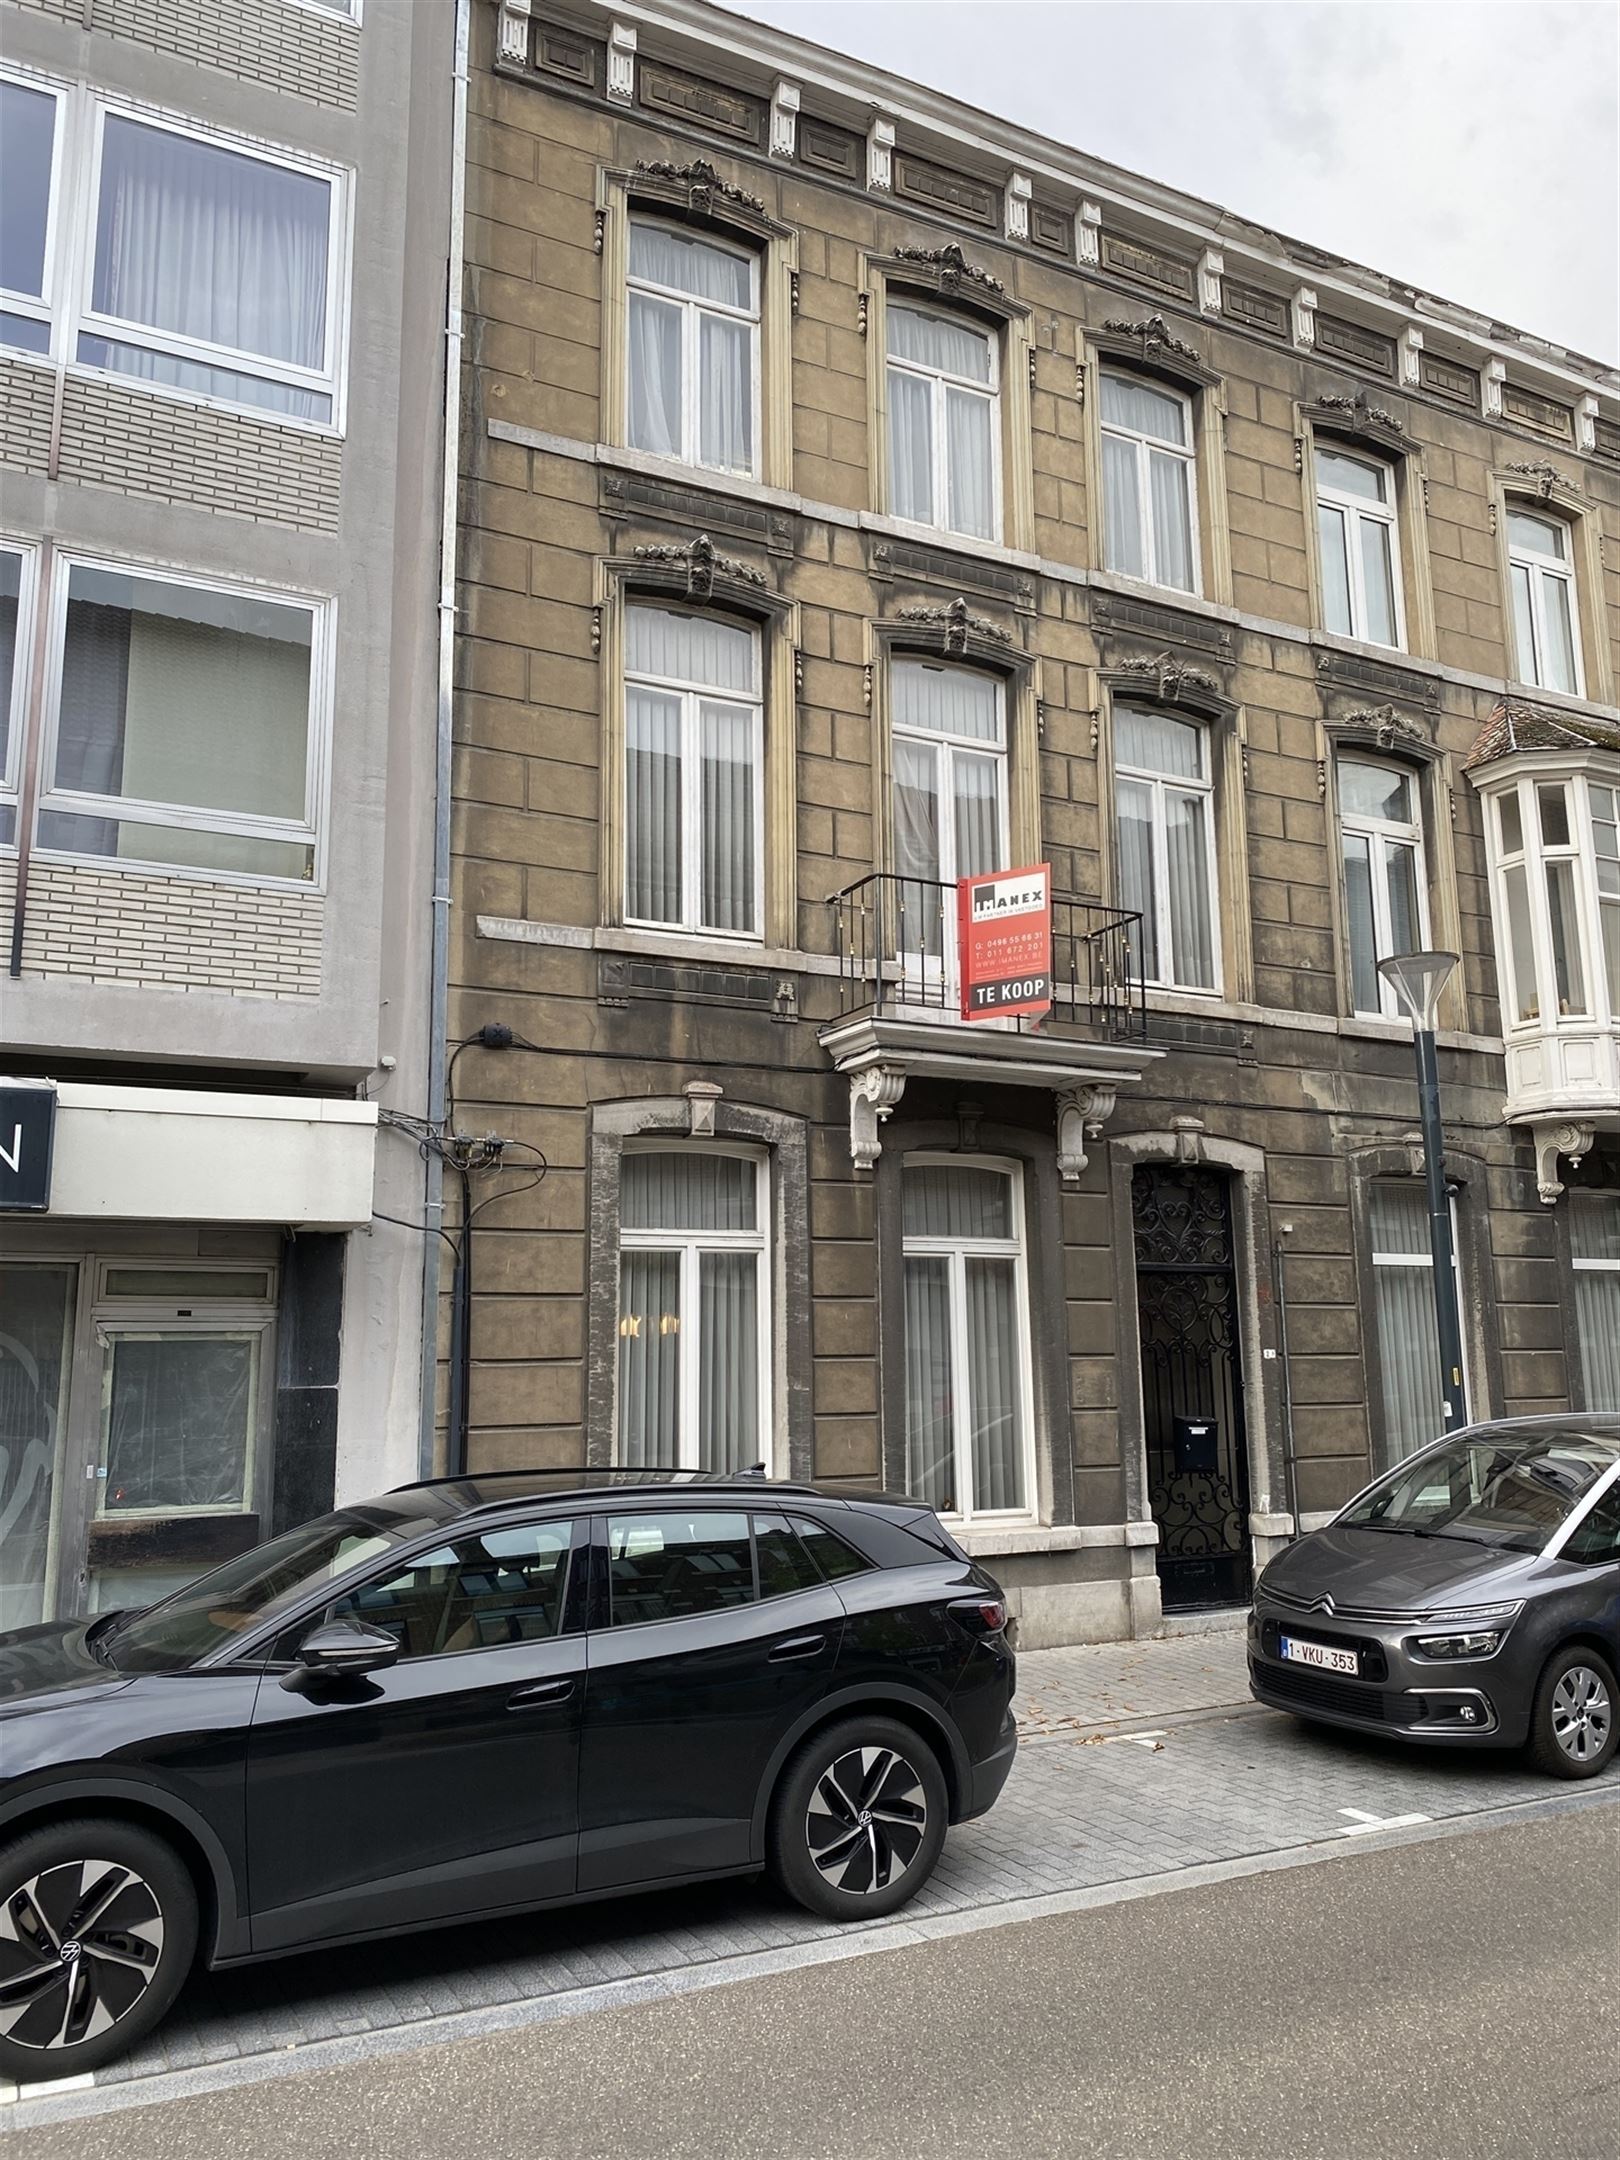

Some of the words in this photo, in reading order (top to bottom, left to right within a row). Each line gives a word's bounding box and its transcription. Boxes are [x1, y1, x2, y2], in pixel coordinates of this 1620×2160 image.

[987, 937, 1007, 947] 0496
[977, 986, 995, 1004] TE
[1001, 979, 1044, 1000] KOOP
